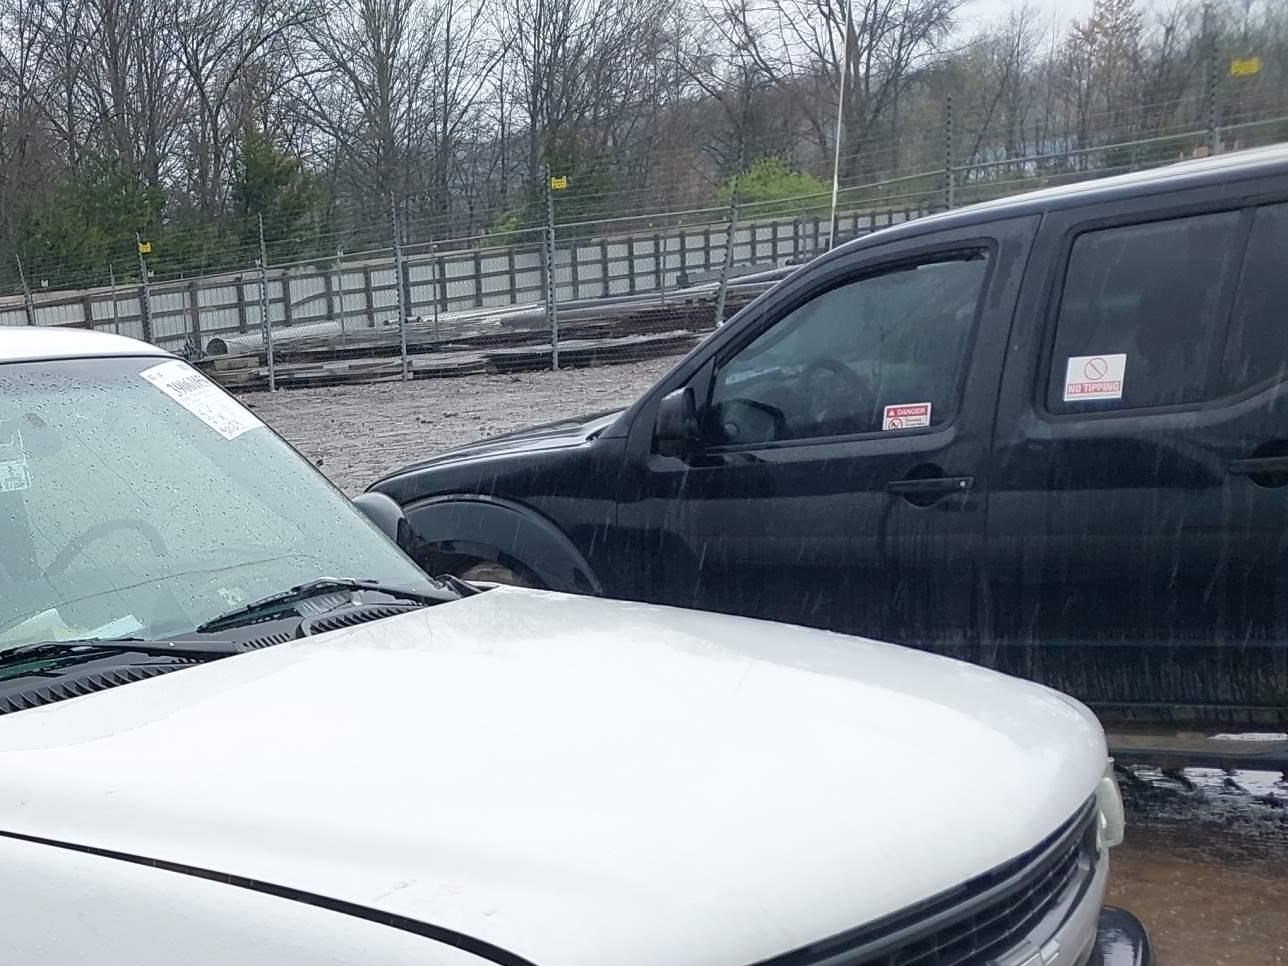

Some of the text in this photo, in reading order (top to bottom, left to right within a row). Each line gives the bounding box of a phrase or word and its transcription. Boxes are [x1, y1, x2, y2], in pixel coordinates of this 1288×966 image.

[1068, 381, 1120, 394] NO TIPPING
[897, 407, 926, 416] DANGER
